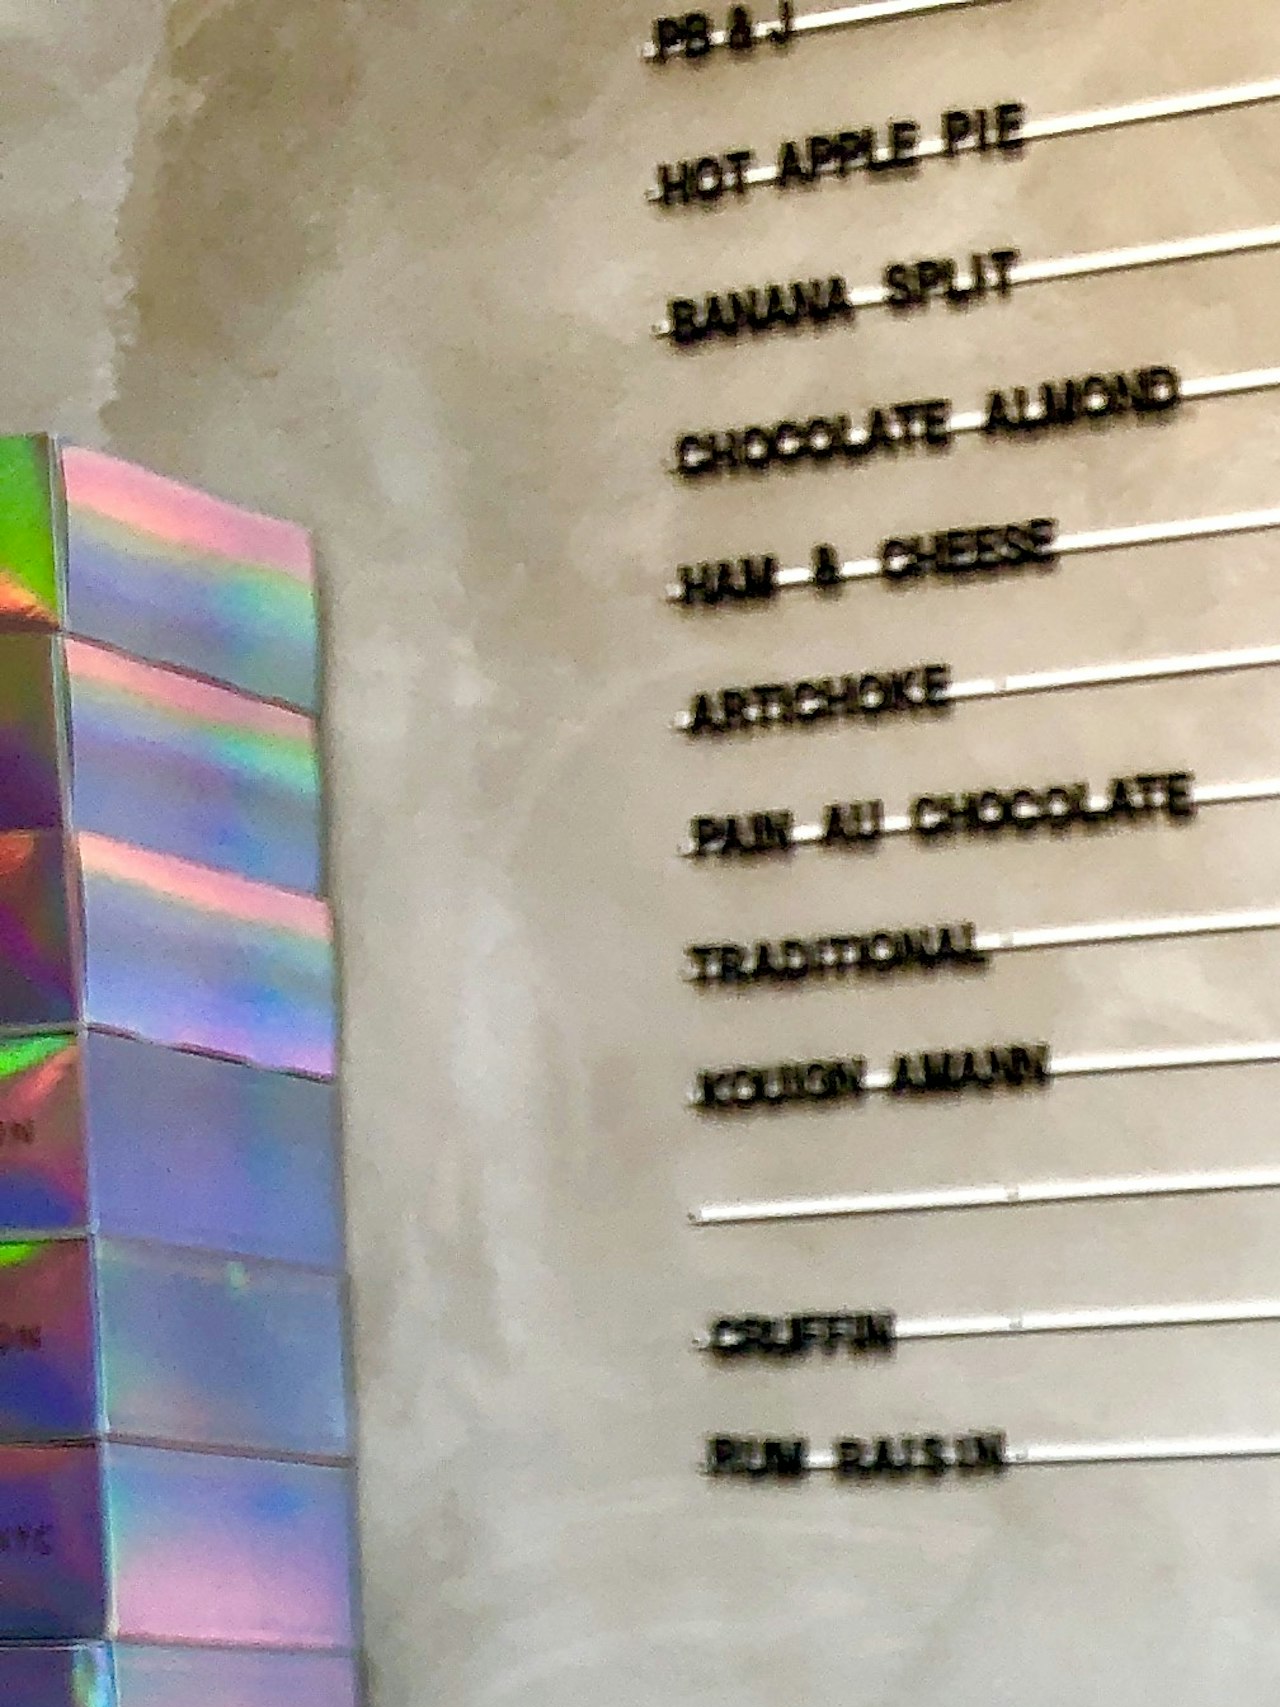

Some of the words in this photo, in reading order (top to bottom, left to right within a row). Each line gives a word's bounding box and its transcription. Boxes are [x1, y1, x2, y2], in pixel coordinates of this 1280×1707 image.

[655, 14, 709, 58] PB
[769, 0, 793, 44] J
[656, 152, 753, 203] HOT
[779, 120, 919, 186] APPLE
[942, 103, 1025, 148] PIE
[667, 276, 849, 341] BANANA
[883, 248, 1020, 303] SPLIT
[675, 399, 951, 473] CHOCOLATE
[984, 364, 1180, 430] ALMOND
[677, 555, 779, 604] HAM
[881, 517, 1059, 577] CHEESE
[690, 663, 951, 732] ARTICHOKE
[689, 809, 795, 857] PAIN
[825, 799, 884, 842] AU
[909, 770, 1196, 836] CHOCOLATE
[687, 920, 980, 984] TRADITIONAL
